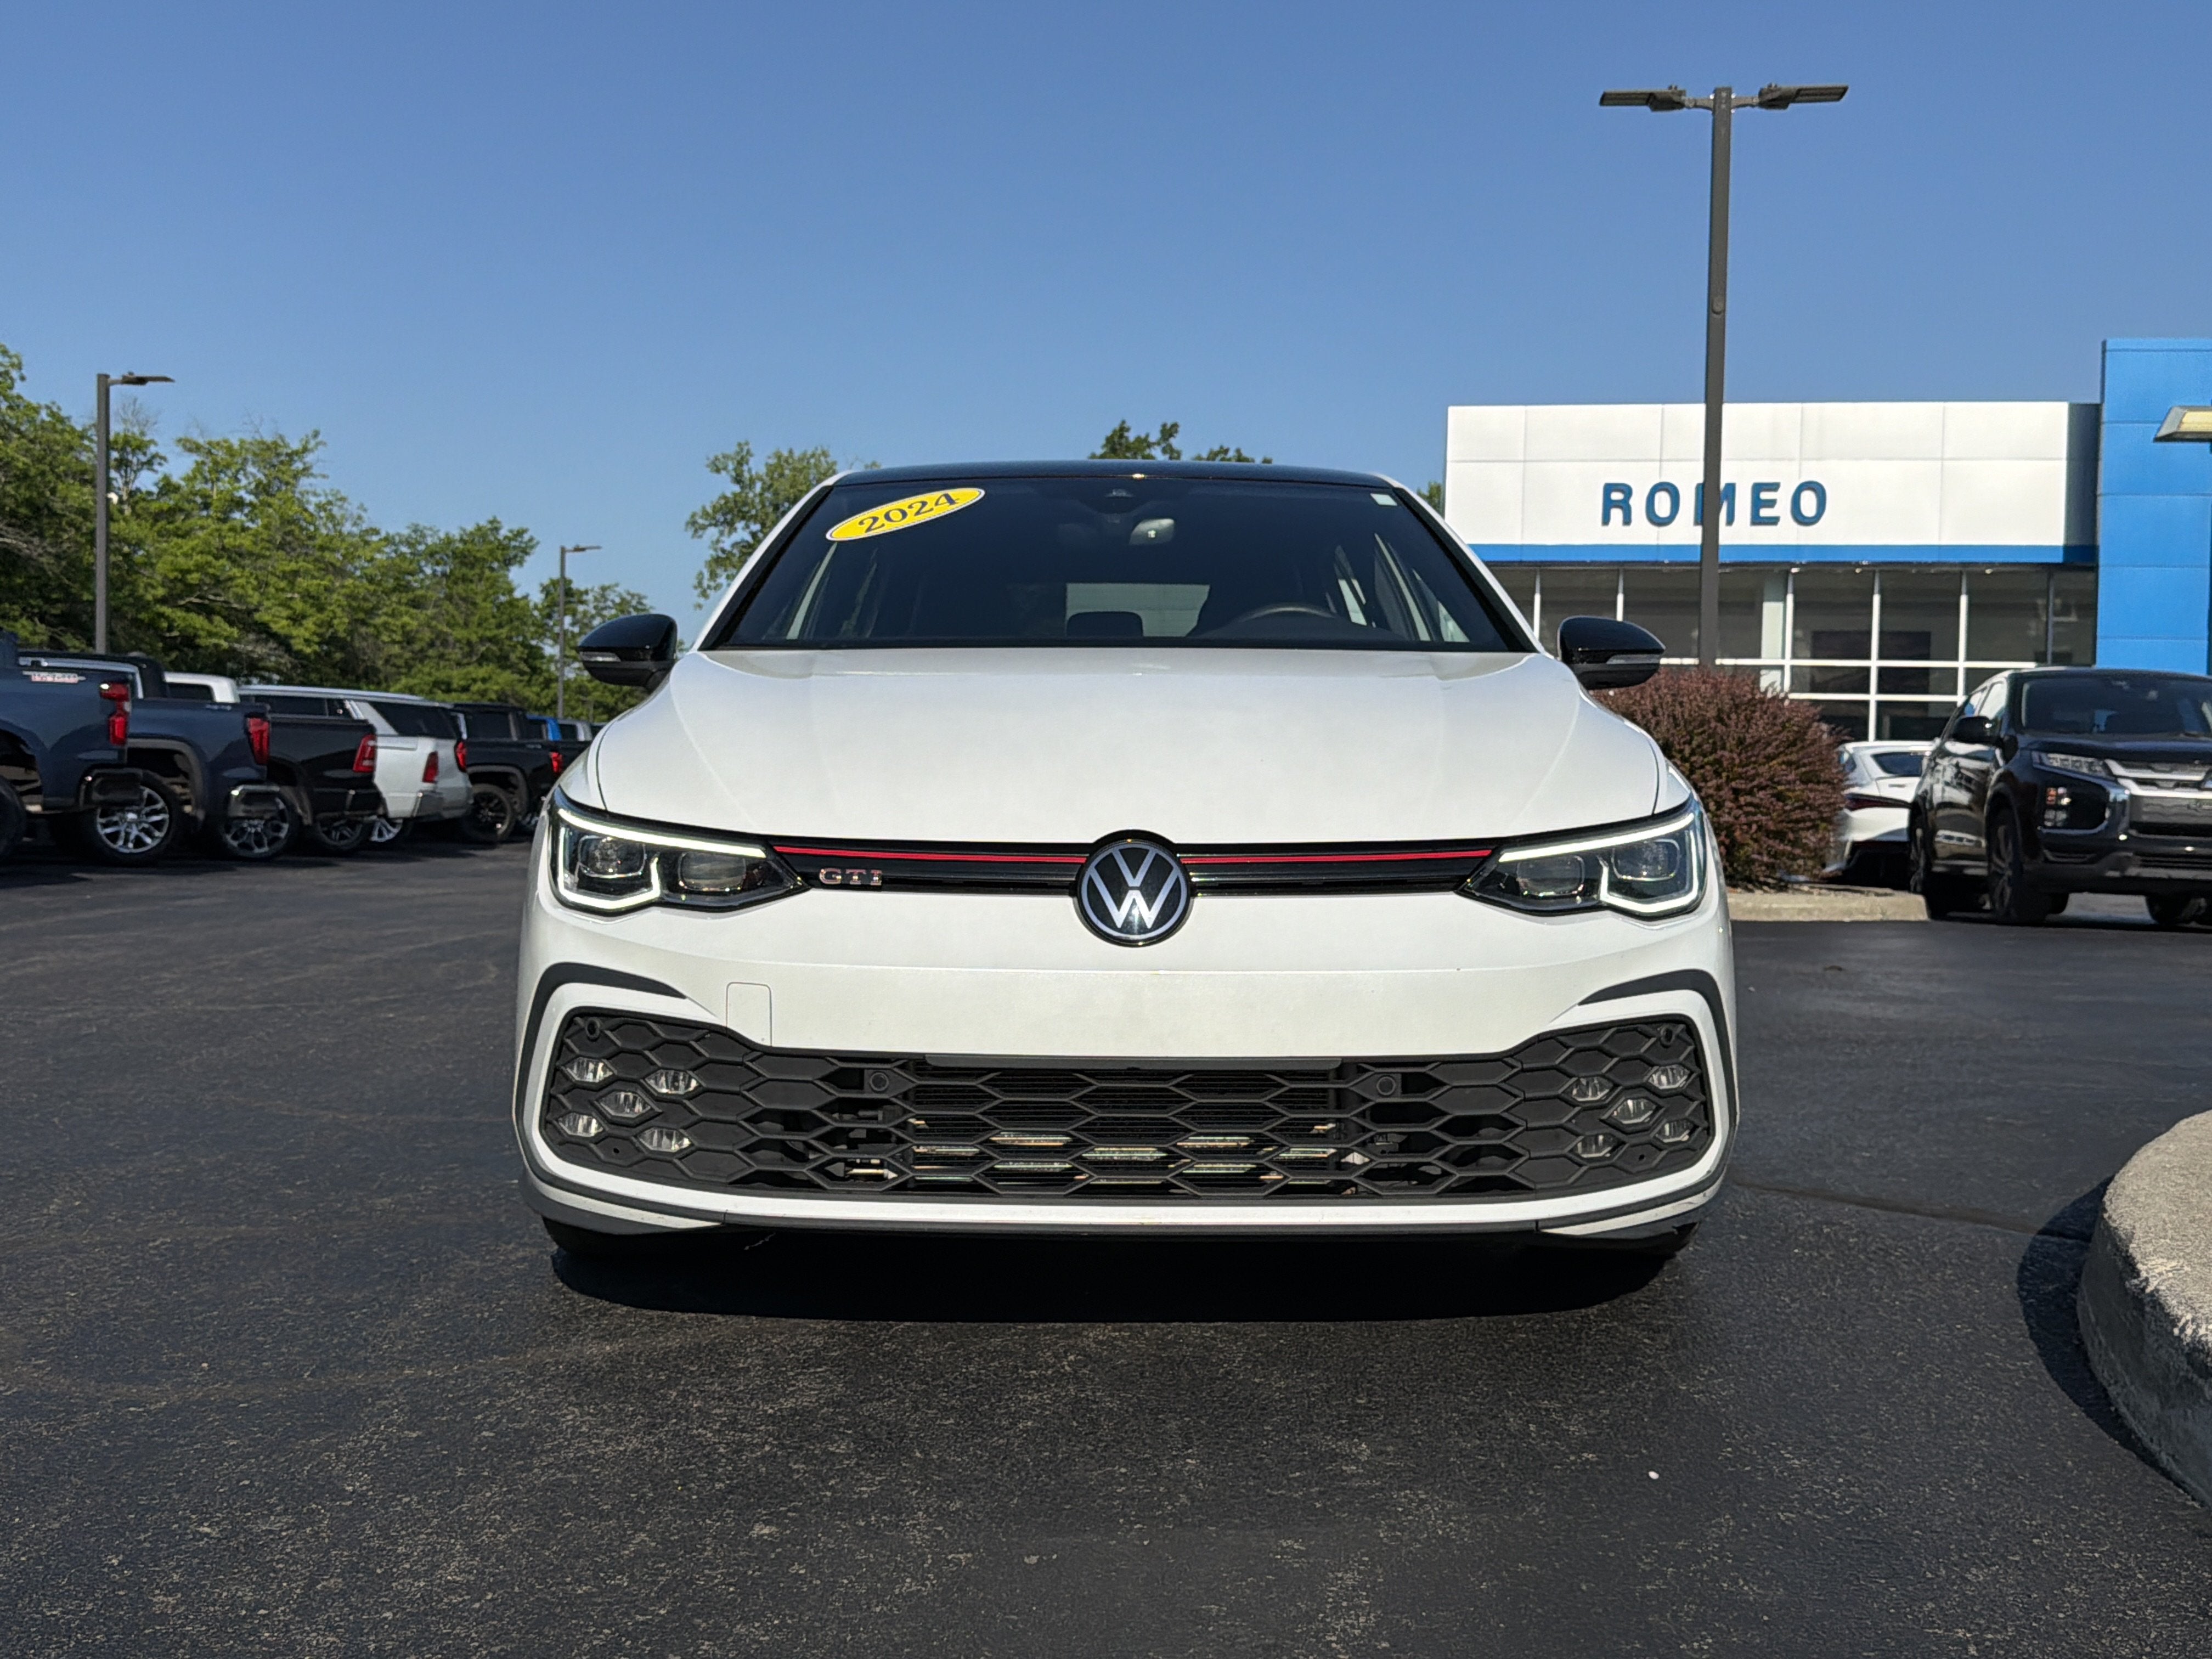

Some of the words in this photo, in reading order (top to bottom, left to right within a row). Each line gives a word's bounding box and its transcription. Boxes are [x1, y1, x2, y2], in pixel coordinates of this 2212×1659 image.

[858, 493, 960, 533] 2024
[819, 867, 882, 885] GTI
[1085, 845, 1183, 934] VW
